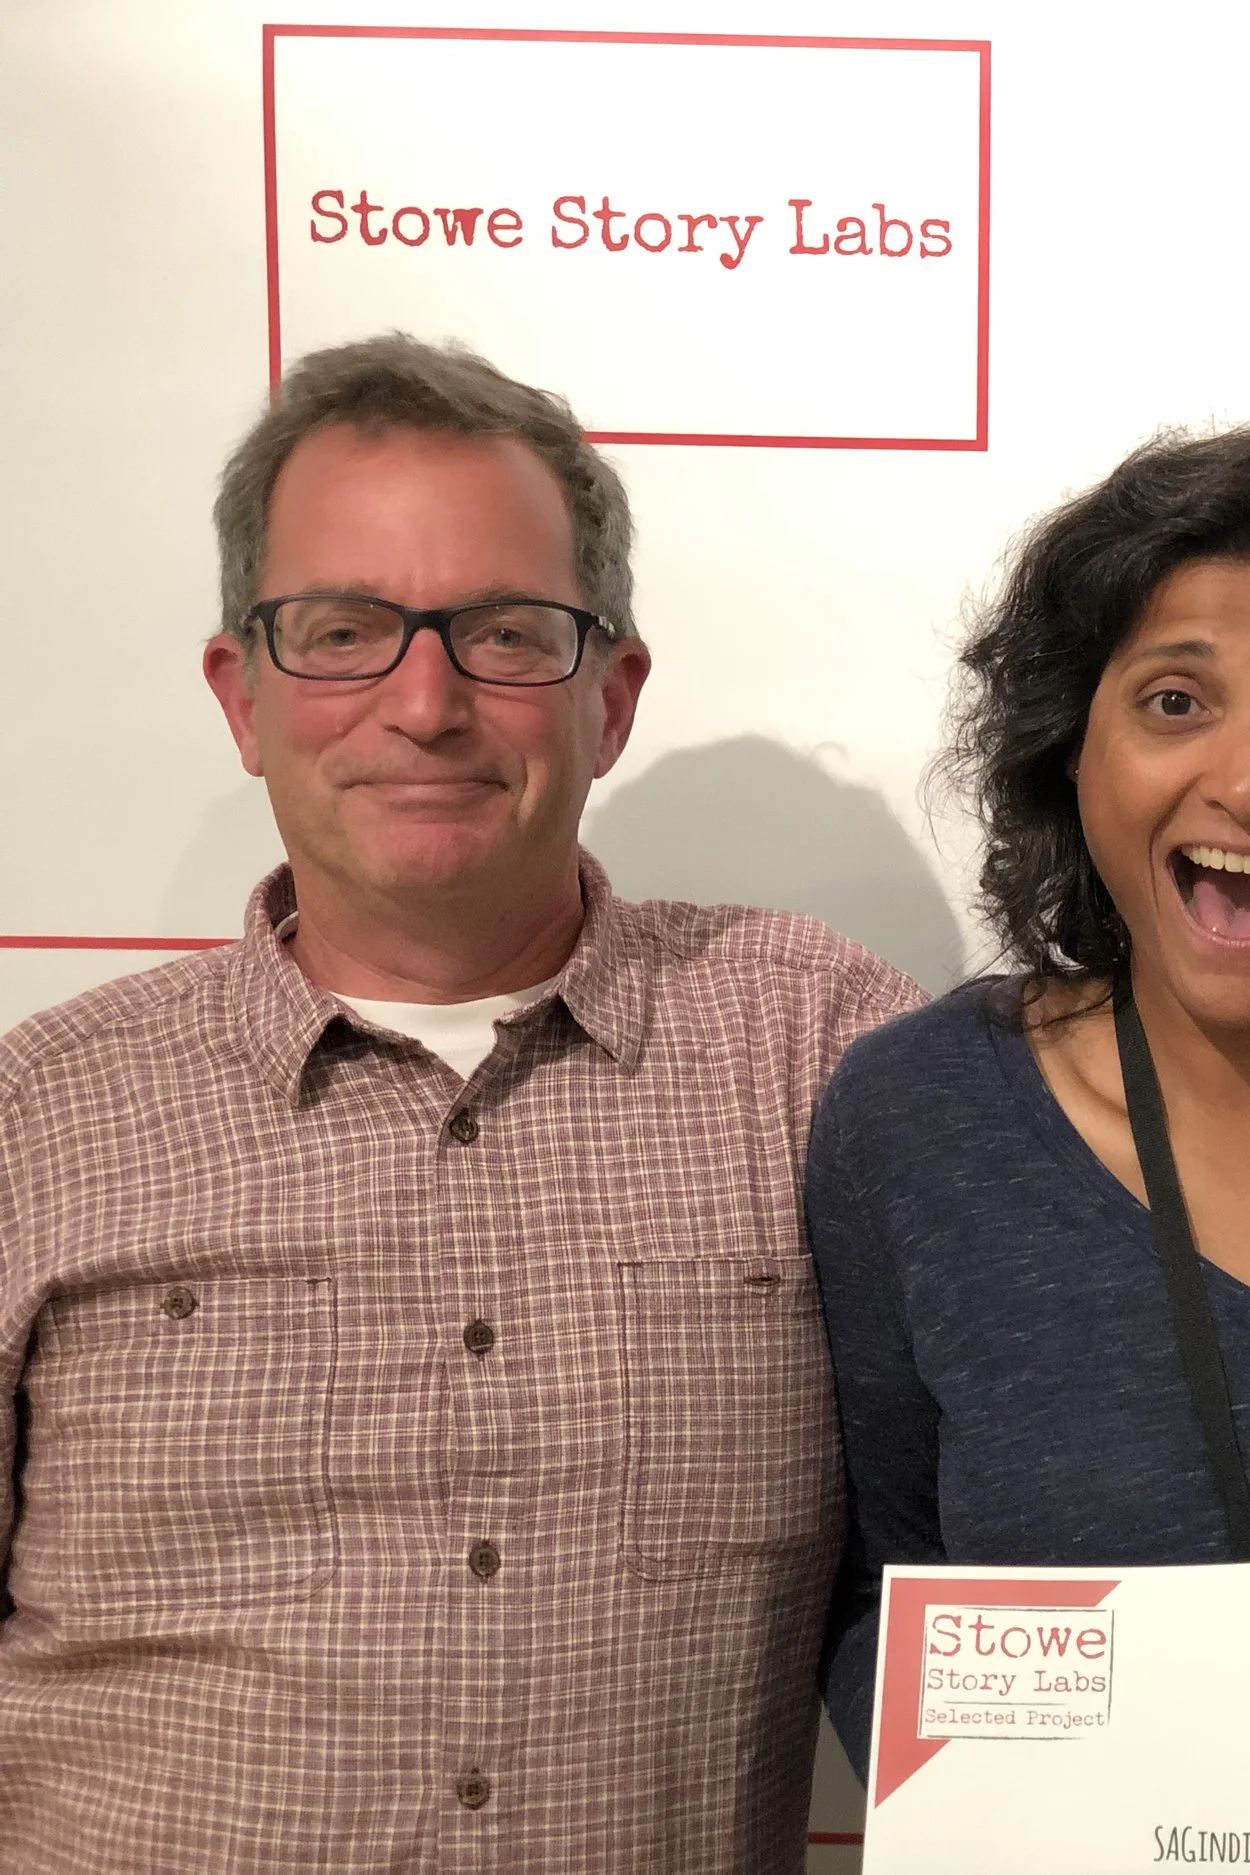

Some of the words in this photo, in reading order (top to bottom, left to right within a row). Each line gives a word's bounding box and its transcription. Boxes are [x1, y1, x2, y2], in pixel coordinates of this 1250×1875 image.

[310, 189, 523, 248] Stowe
[551, 195, 765, 271] Story
[787, 198, 953, 260] Labs
[928, 1613, 1107, 1660] Stowe
[926, 1668, 1017, 1697] Story
[1033, 1670, 1107, 1693] Labs
[924, 1708, 1017, 1726] Selected
[1026, 1710, 1105, 1730] Project
